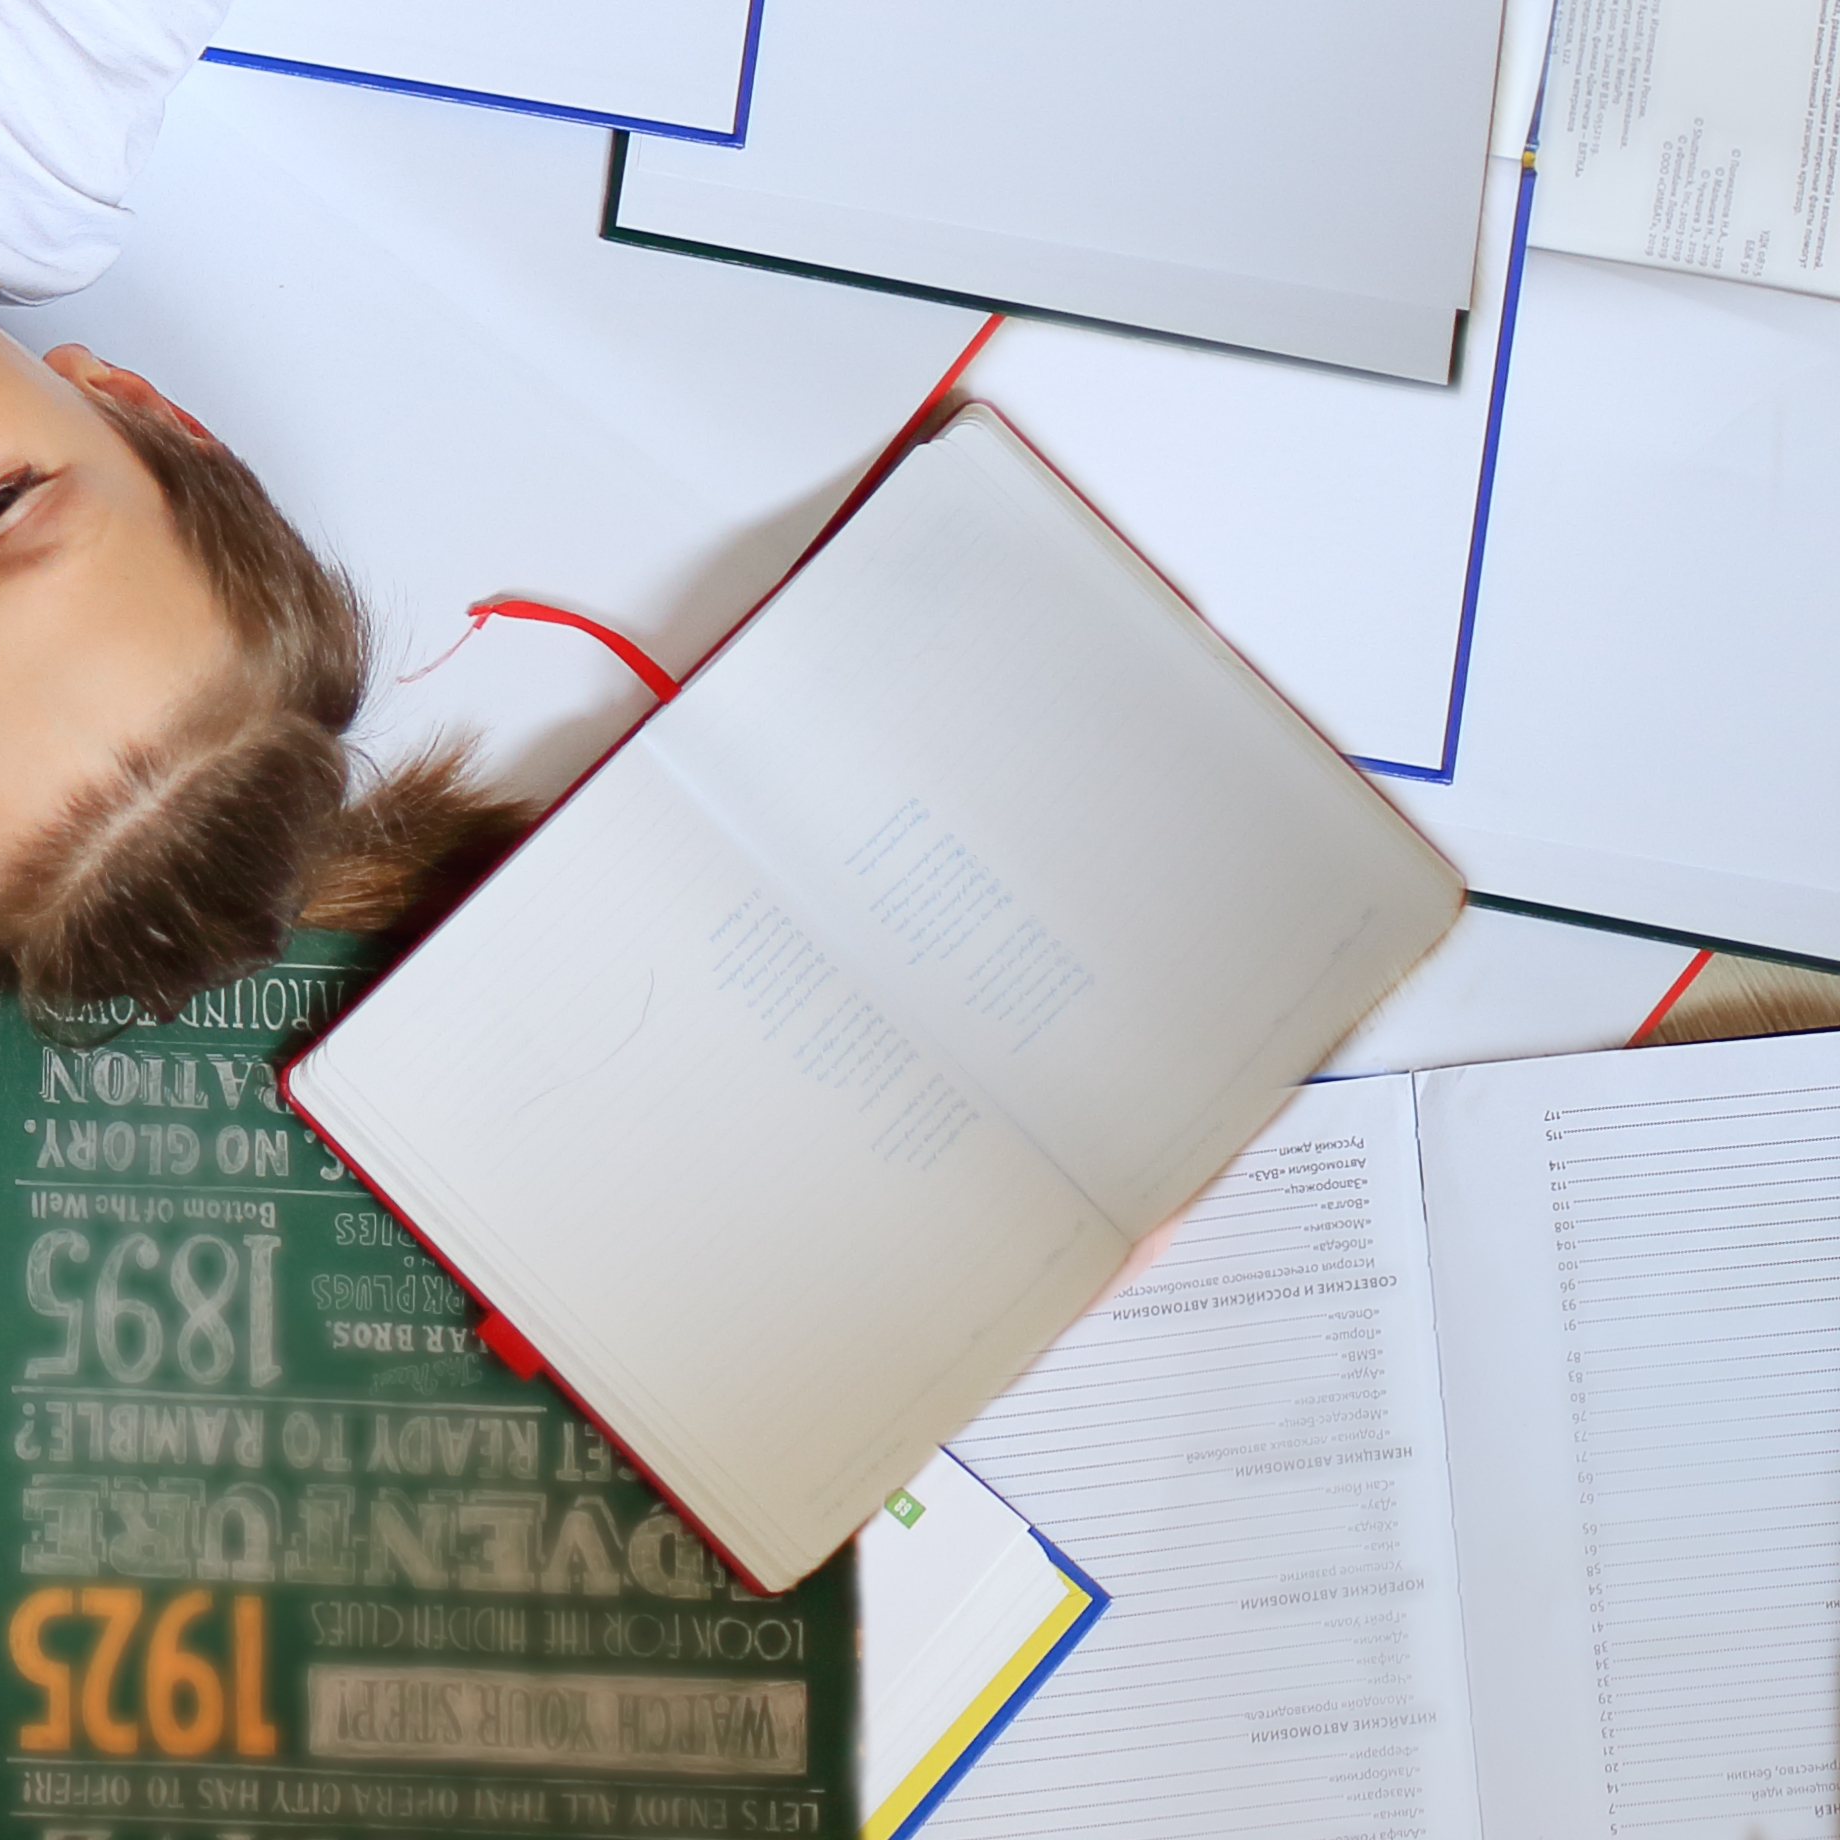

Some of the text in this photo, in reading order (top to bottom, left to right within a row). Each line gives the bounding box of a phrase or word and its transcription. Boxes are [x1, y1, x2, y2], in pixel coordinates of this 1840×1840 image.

[1544, 1109, 1561, 1122] 117
[23, 1118, 289, 1177] NO GLORY.
[1278, 1136, 1365, 1158] Русский джип
[31, 1190, 276, 1228] Bottom Of The Well
[24, 1228, 282, 1387] 1895
[311, 1273, 416, 1313] PLUGS
[1112, 1275, 1397, 1322] СОВЕТСКИЕ И РОССИЙСКИЕ АВТОМОБИЛИ
[324, 1320, 414, 1352] BROS.
[15, 1402, 263, 1468] RAMBLE?
[283, 1410, 350, 1472] TO
[367, 1413, 540, 1479] READY
[20, 1473, 783, 1602] DVENTURE
[310, 1600, 804, 1661] LOOK FOR THE HIDDEN CLUES
[9, 1588, 277, 1758] 1925
[336, 1679, 779, 1760] WATCH YOUR STEP!
[1250, 1711, 1436, 1744] КИТАЙСКИЕ АВТОМОБИЛИ
[22, 1771, 131, 1806] OFFER!
[147, 1776, 185, 1810] TO
[198, 1777, 260, 1811] HAS
[272, 1780, 341, 1814] CITY
[352, 1783, 458, 1820] OPERA
[473, 1788, 550, 1823] THAT
[561, 1793, 617, 1825] ALL
[630, 1796, 726, 1830] ENJOY
